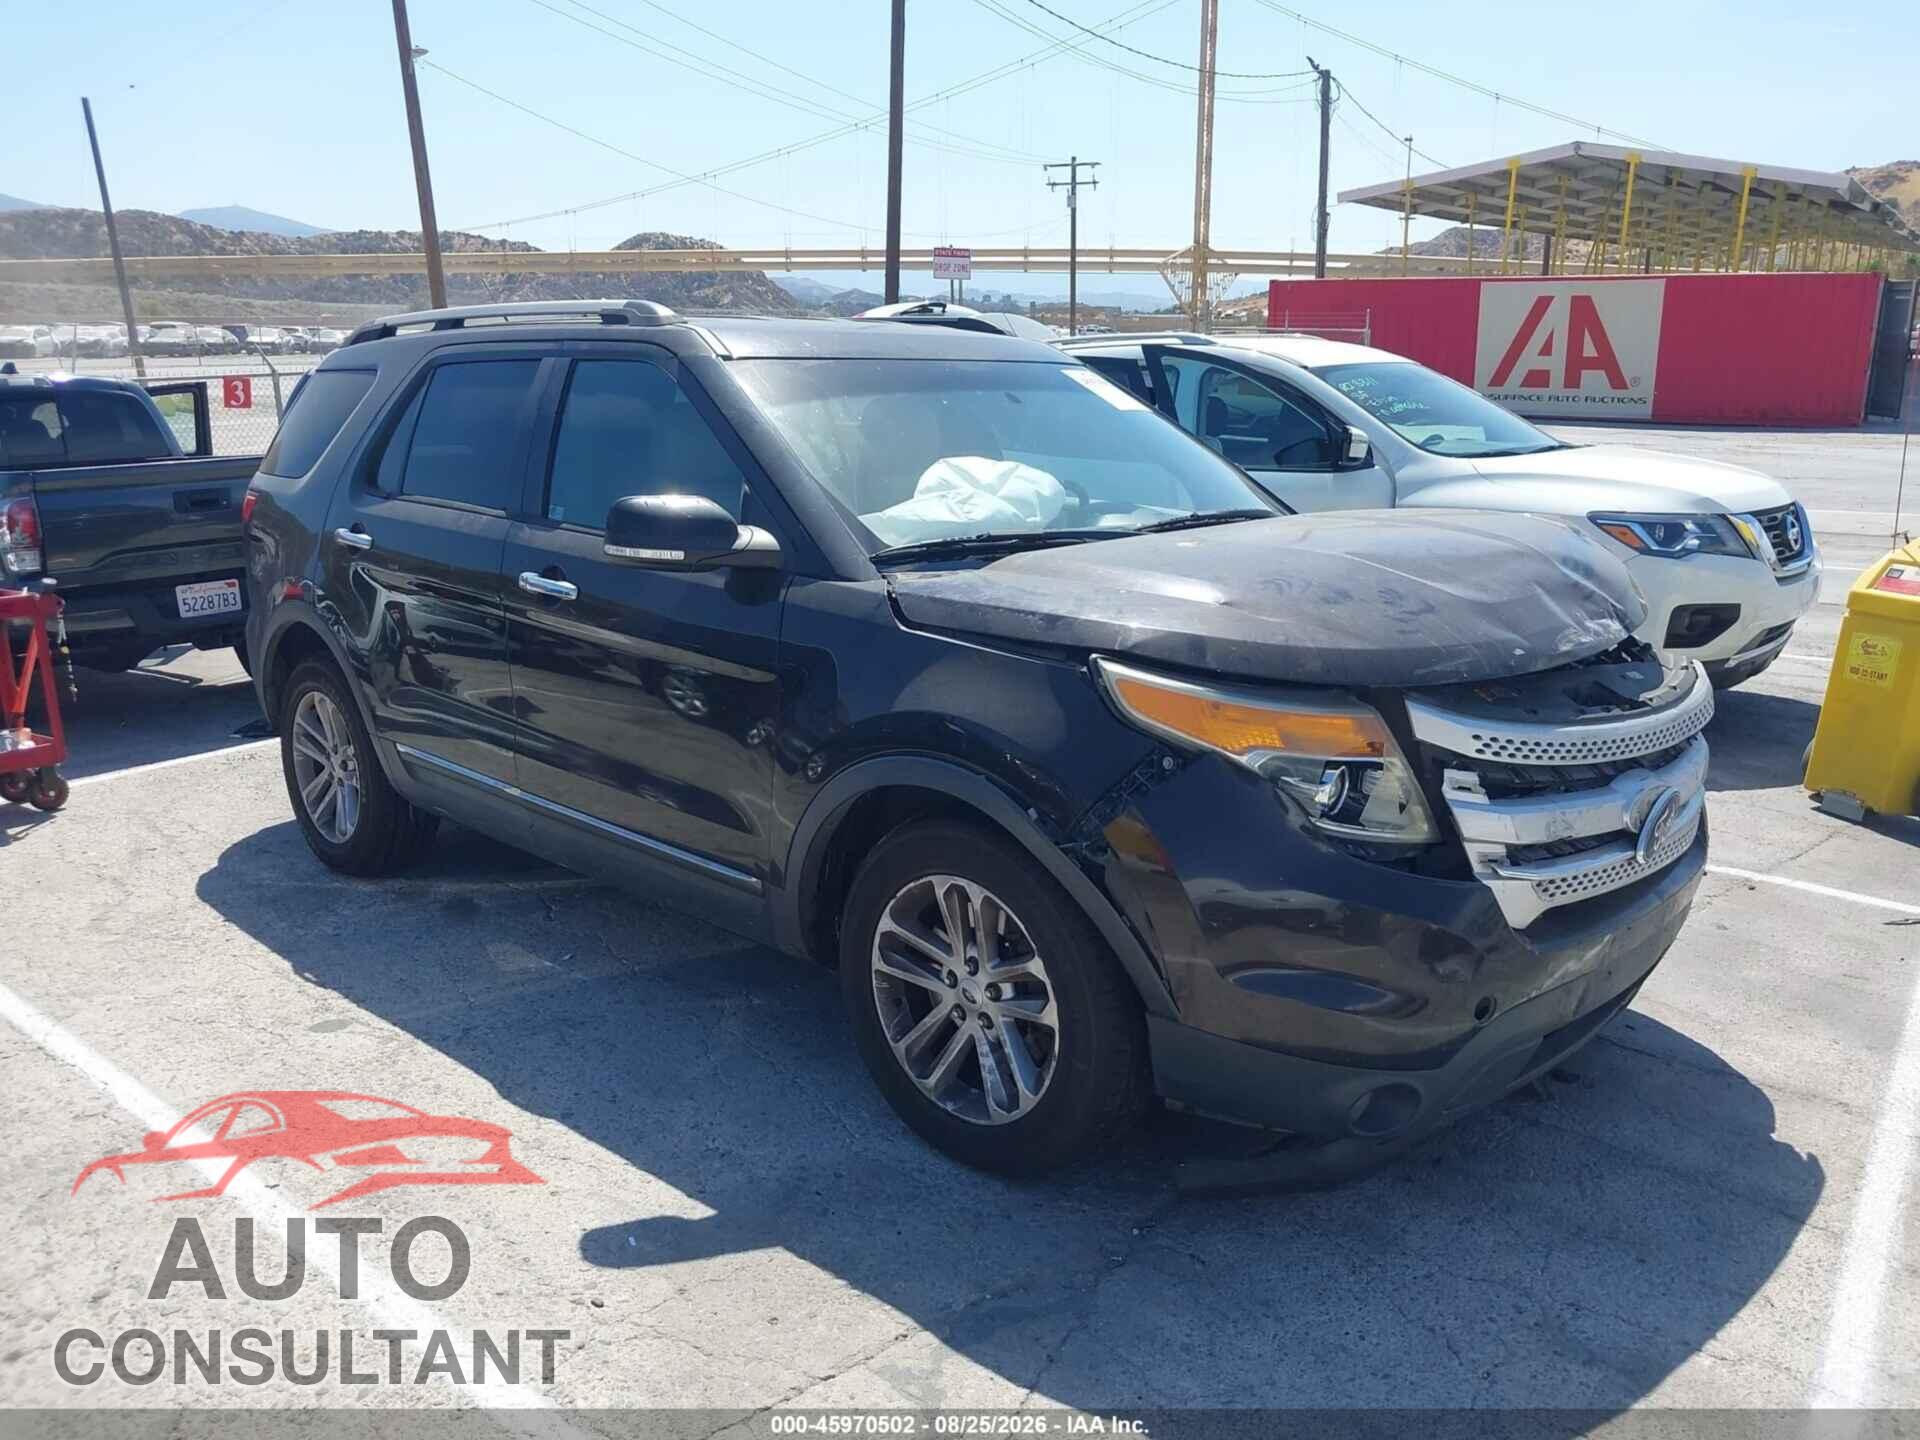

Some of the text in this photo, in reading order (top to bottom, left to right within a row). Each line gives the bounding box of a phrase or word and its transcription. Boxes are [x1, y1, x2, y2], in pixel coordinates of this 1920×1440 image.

[953, 263, 969, 272] ZONE
[230, 380, 245, 406] 3
[182, 592, 237, 613] 52287B3
